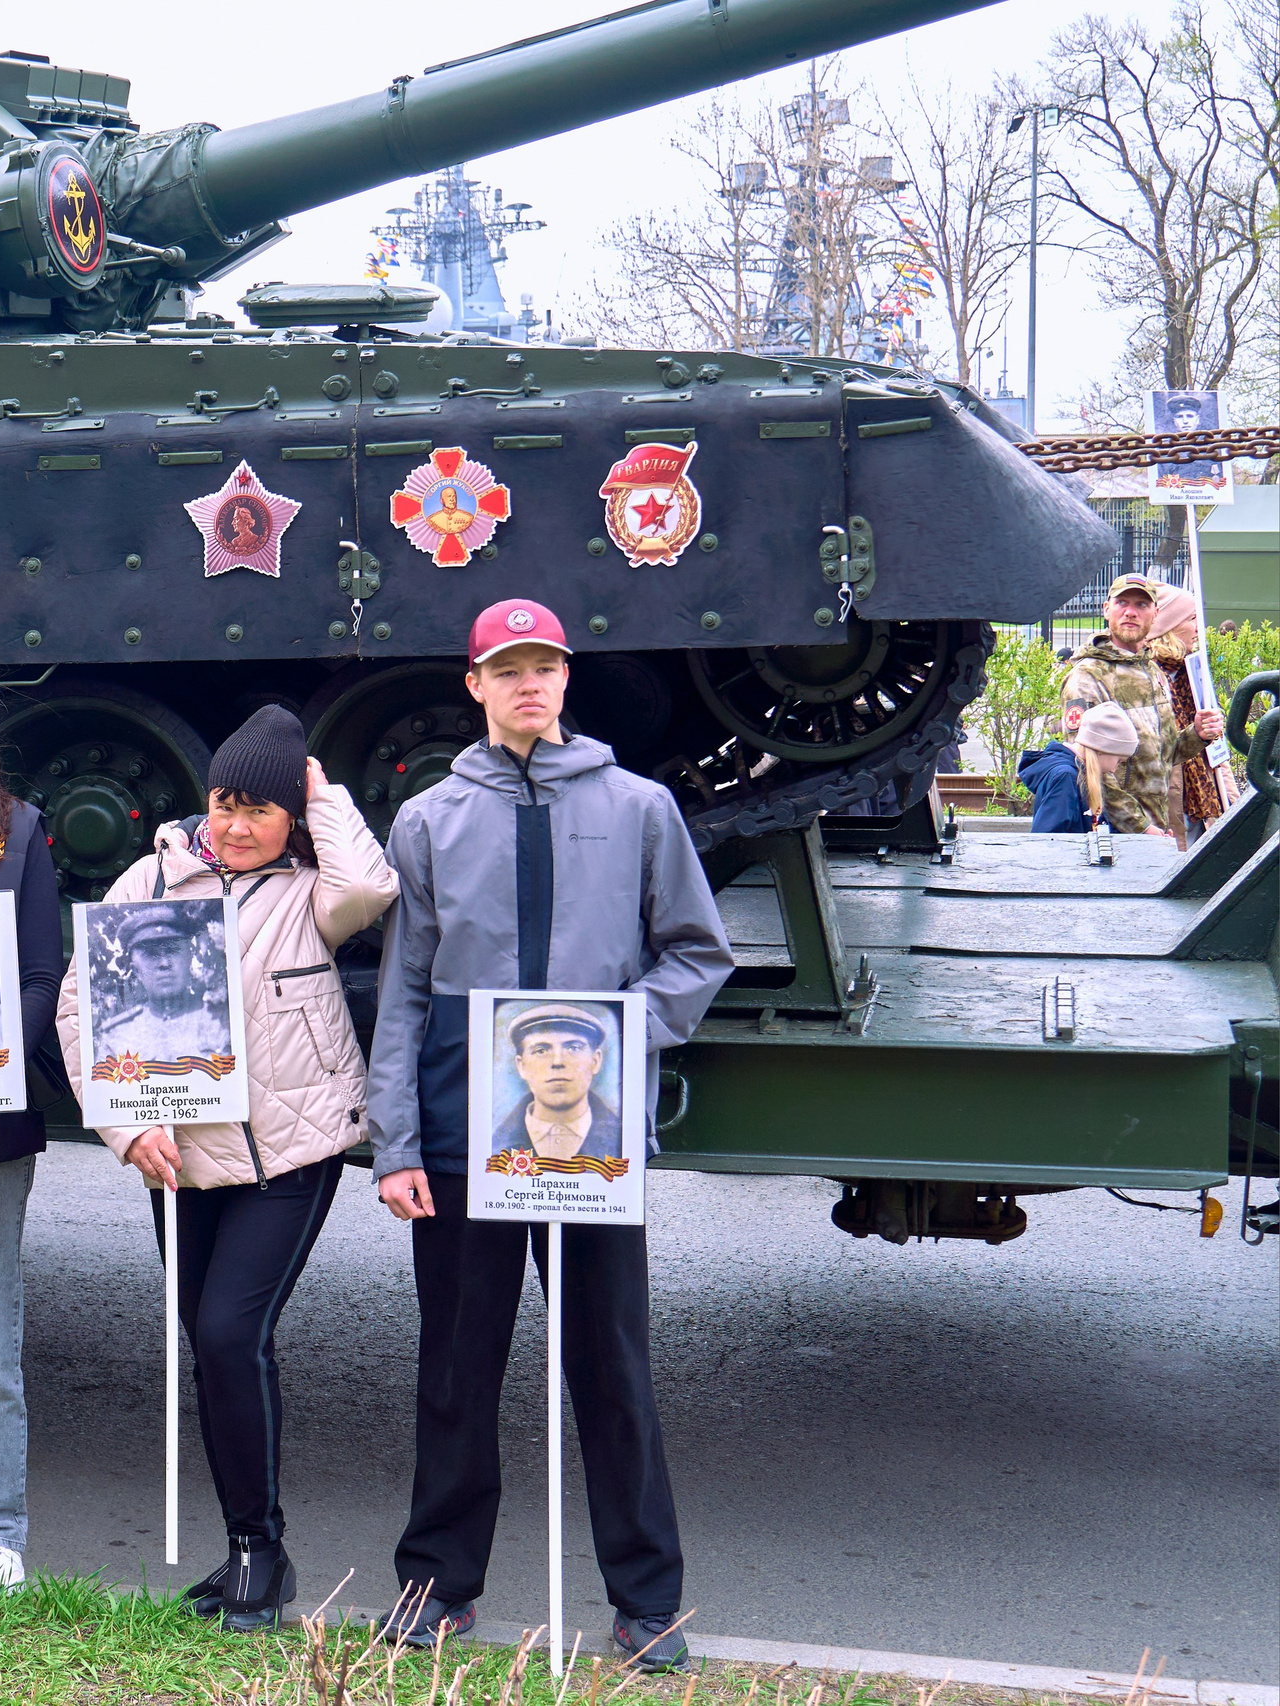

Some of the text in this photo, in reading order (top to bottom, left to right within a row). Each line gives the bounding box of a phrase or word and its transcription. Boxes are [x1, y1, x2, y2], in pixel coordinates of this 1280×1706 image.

[617, 458, 680, 479] ГВАРДИЯ
[140, 1084, 189, 1097] Парахин
[0, 1097, 13, 1106] гг.
[110, 1096, 221, 1109] Николай Сергеевич
[134, 1109, 160, 1121] 1922
[172, 1108, 198, 1120] 1962
[531, 1178, 580, 1190] Парахин
[504, 1189, 606, 1203] Сергей Ефимович
[484, 1201, 526, 1210] 18.09.1902
[532, 1204, 561, 1212] пропал
[562, 1203, 576, 1212] без
[577, 1205, 600, 1213] вести
[608, 1205, 627, 1213] 1941
